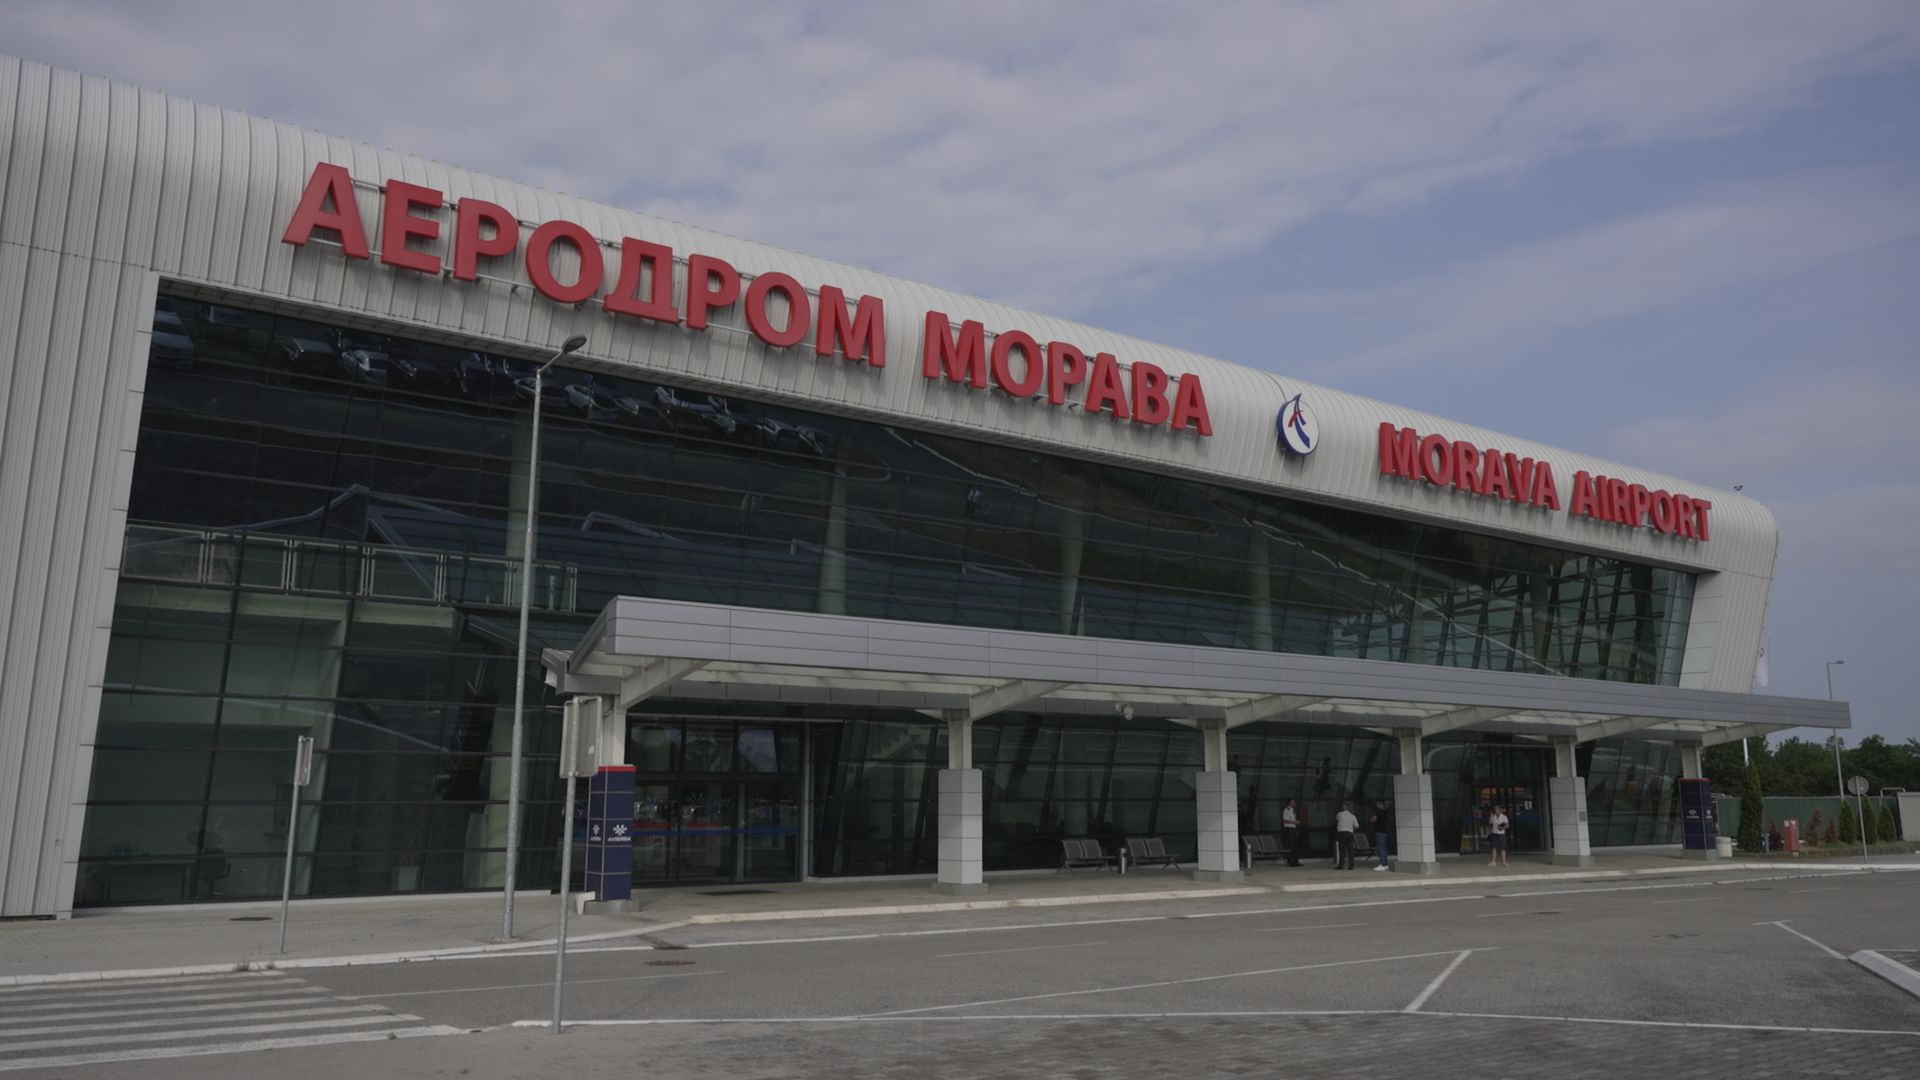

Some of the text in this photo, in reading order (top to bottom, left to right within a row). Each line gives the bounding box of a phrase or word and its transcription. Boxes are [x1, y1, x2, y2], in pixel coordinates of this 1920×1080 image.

[283, 162, 1213, 437] АЕРОДРОМ МОРАВА
[1378, 421, 1711, 541] MORAVA AIRPORT
